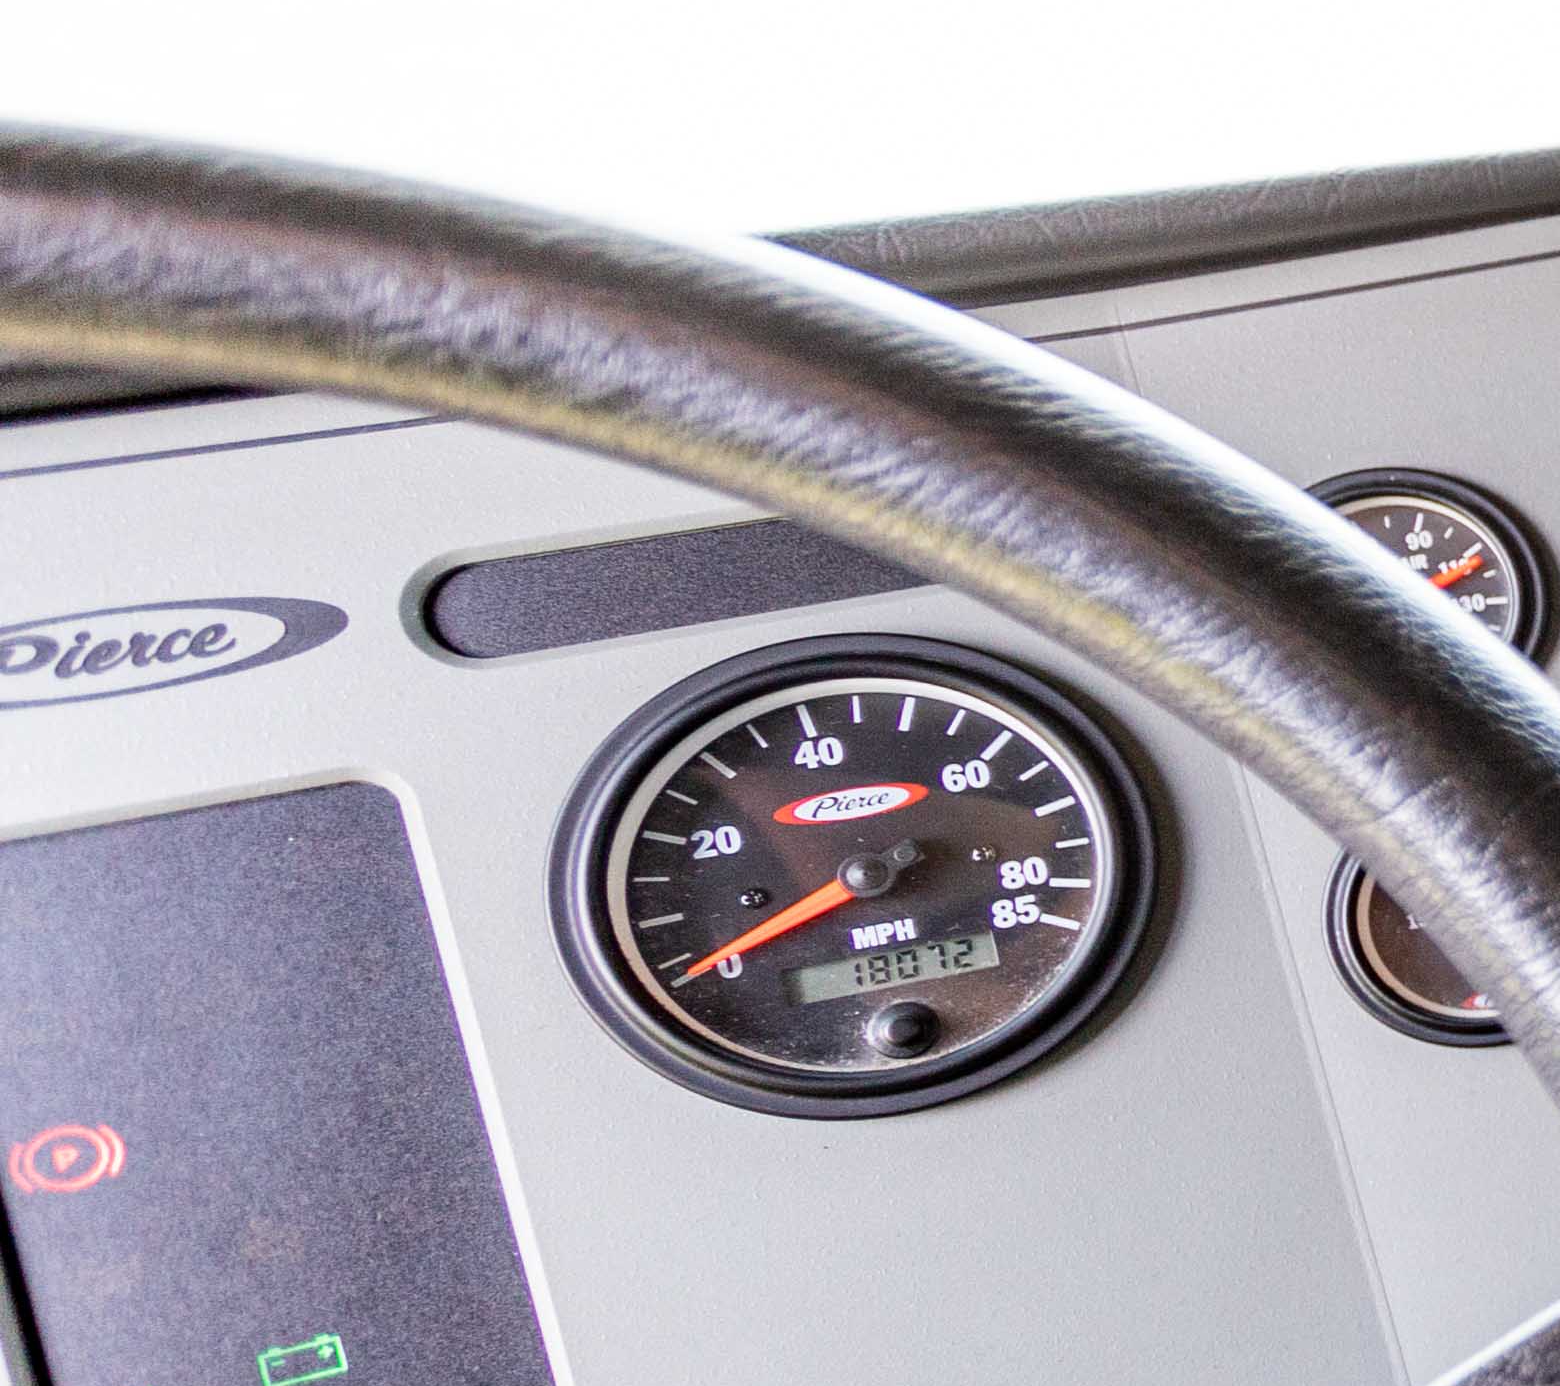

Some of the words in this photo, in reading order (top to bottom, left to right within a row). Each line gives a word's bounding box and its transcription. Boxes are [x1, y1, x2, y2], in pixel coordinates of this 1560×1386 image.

[1405, 530, 1433, 551] 90
[794, 737, 843, 769] 40
[942, 760, 990, 793] 60
[812, 791, 890, 819] Pierce
[690, 826, 742, 859] 20
[1000, 856, 1048, 889] 80
[991, 895, 1040, 929] 85
[851, 918, 916, 950] MPH
[854, 939, 974, 987] 18072
